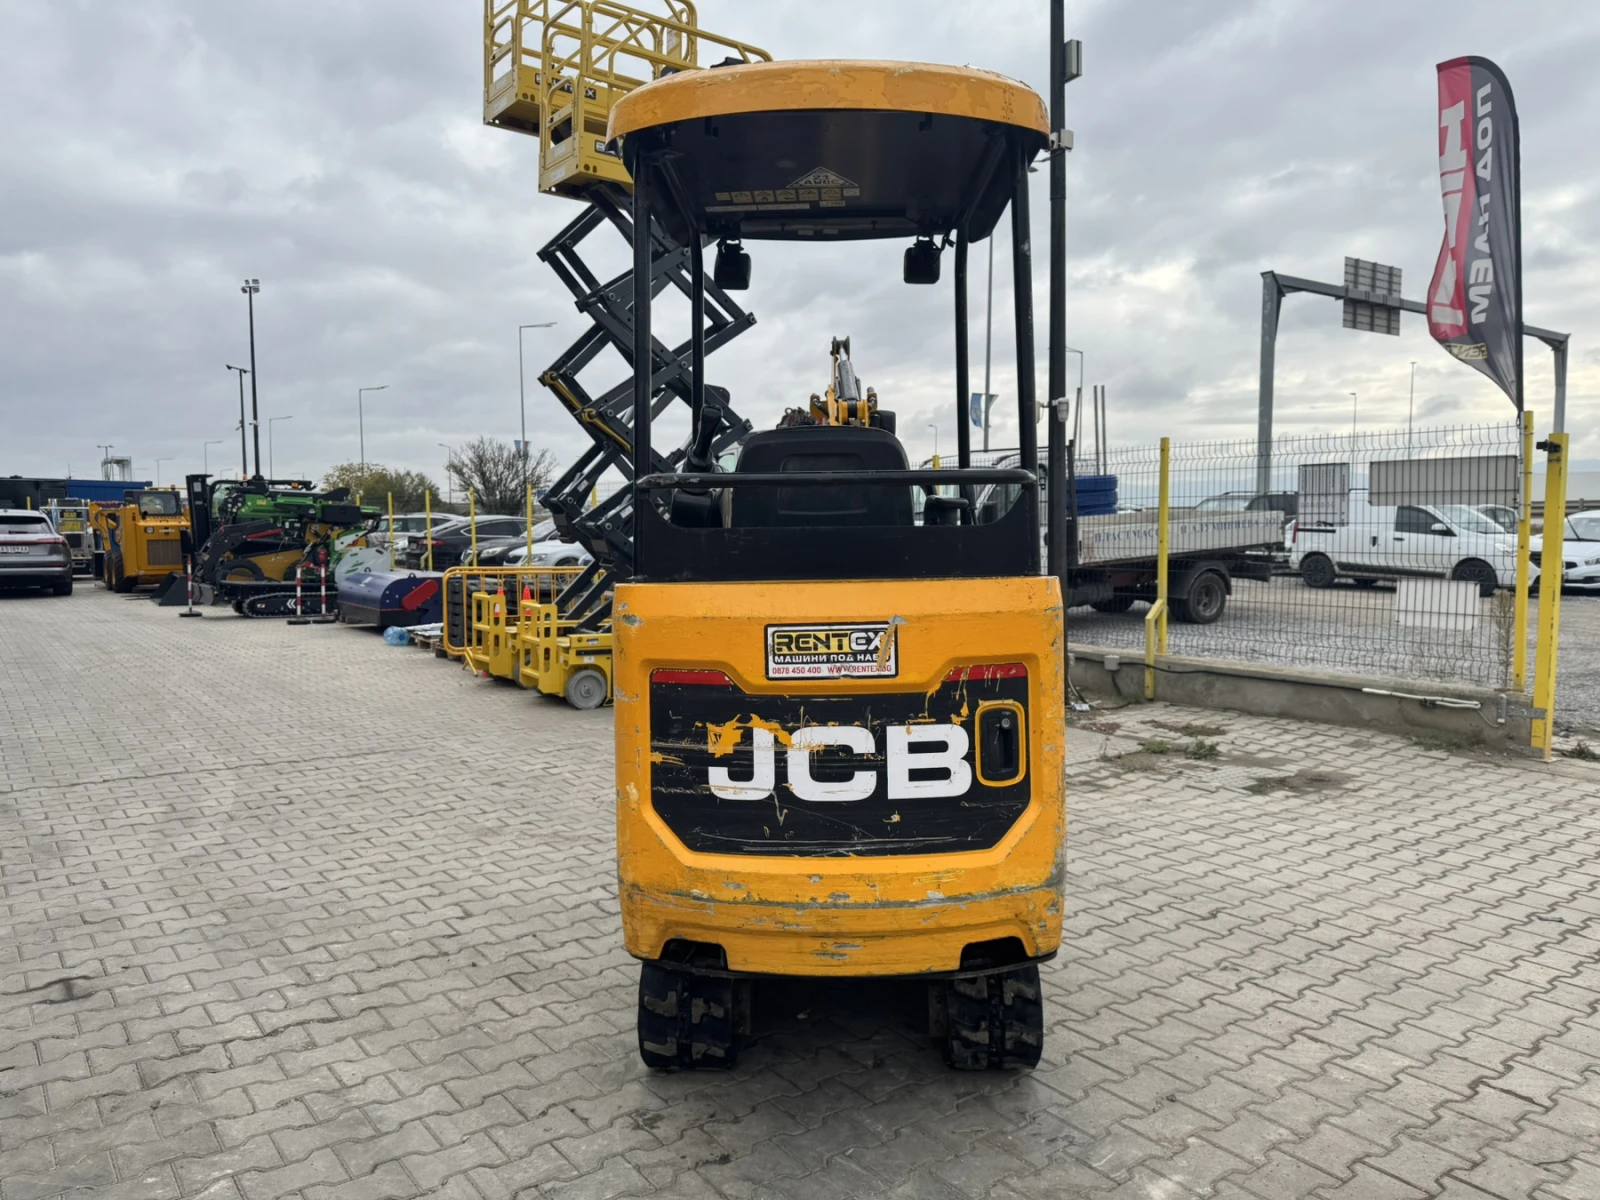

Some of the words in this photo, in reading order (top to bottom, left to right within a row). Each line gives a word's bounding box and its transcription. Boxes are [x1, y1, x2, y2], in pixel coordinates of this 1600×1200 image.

[775, 631, 886, 652] RENTEX
[774, 655, 827, 663] МАШИНИ
[830, 654, 854, 662] ПОД
[857, 653, 888, 661] НАЕ
[792, 666, 805, 674] 450
[707, 722, 972, 802] JCB
